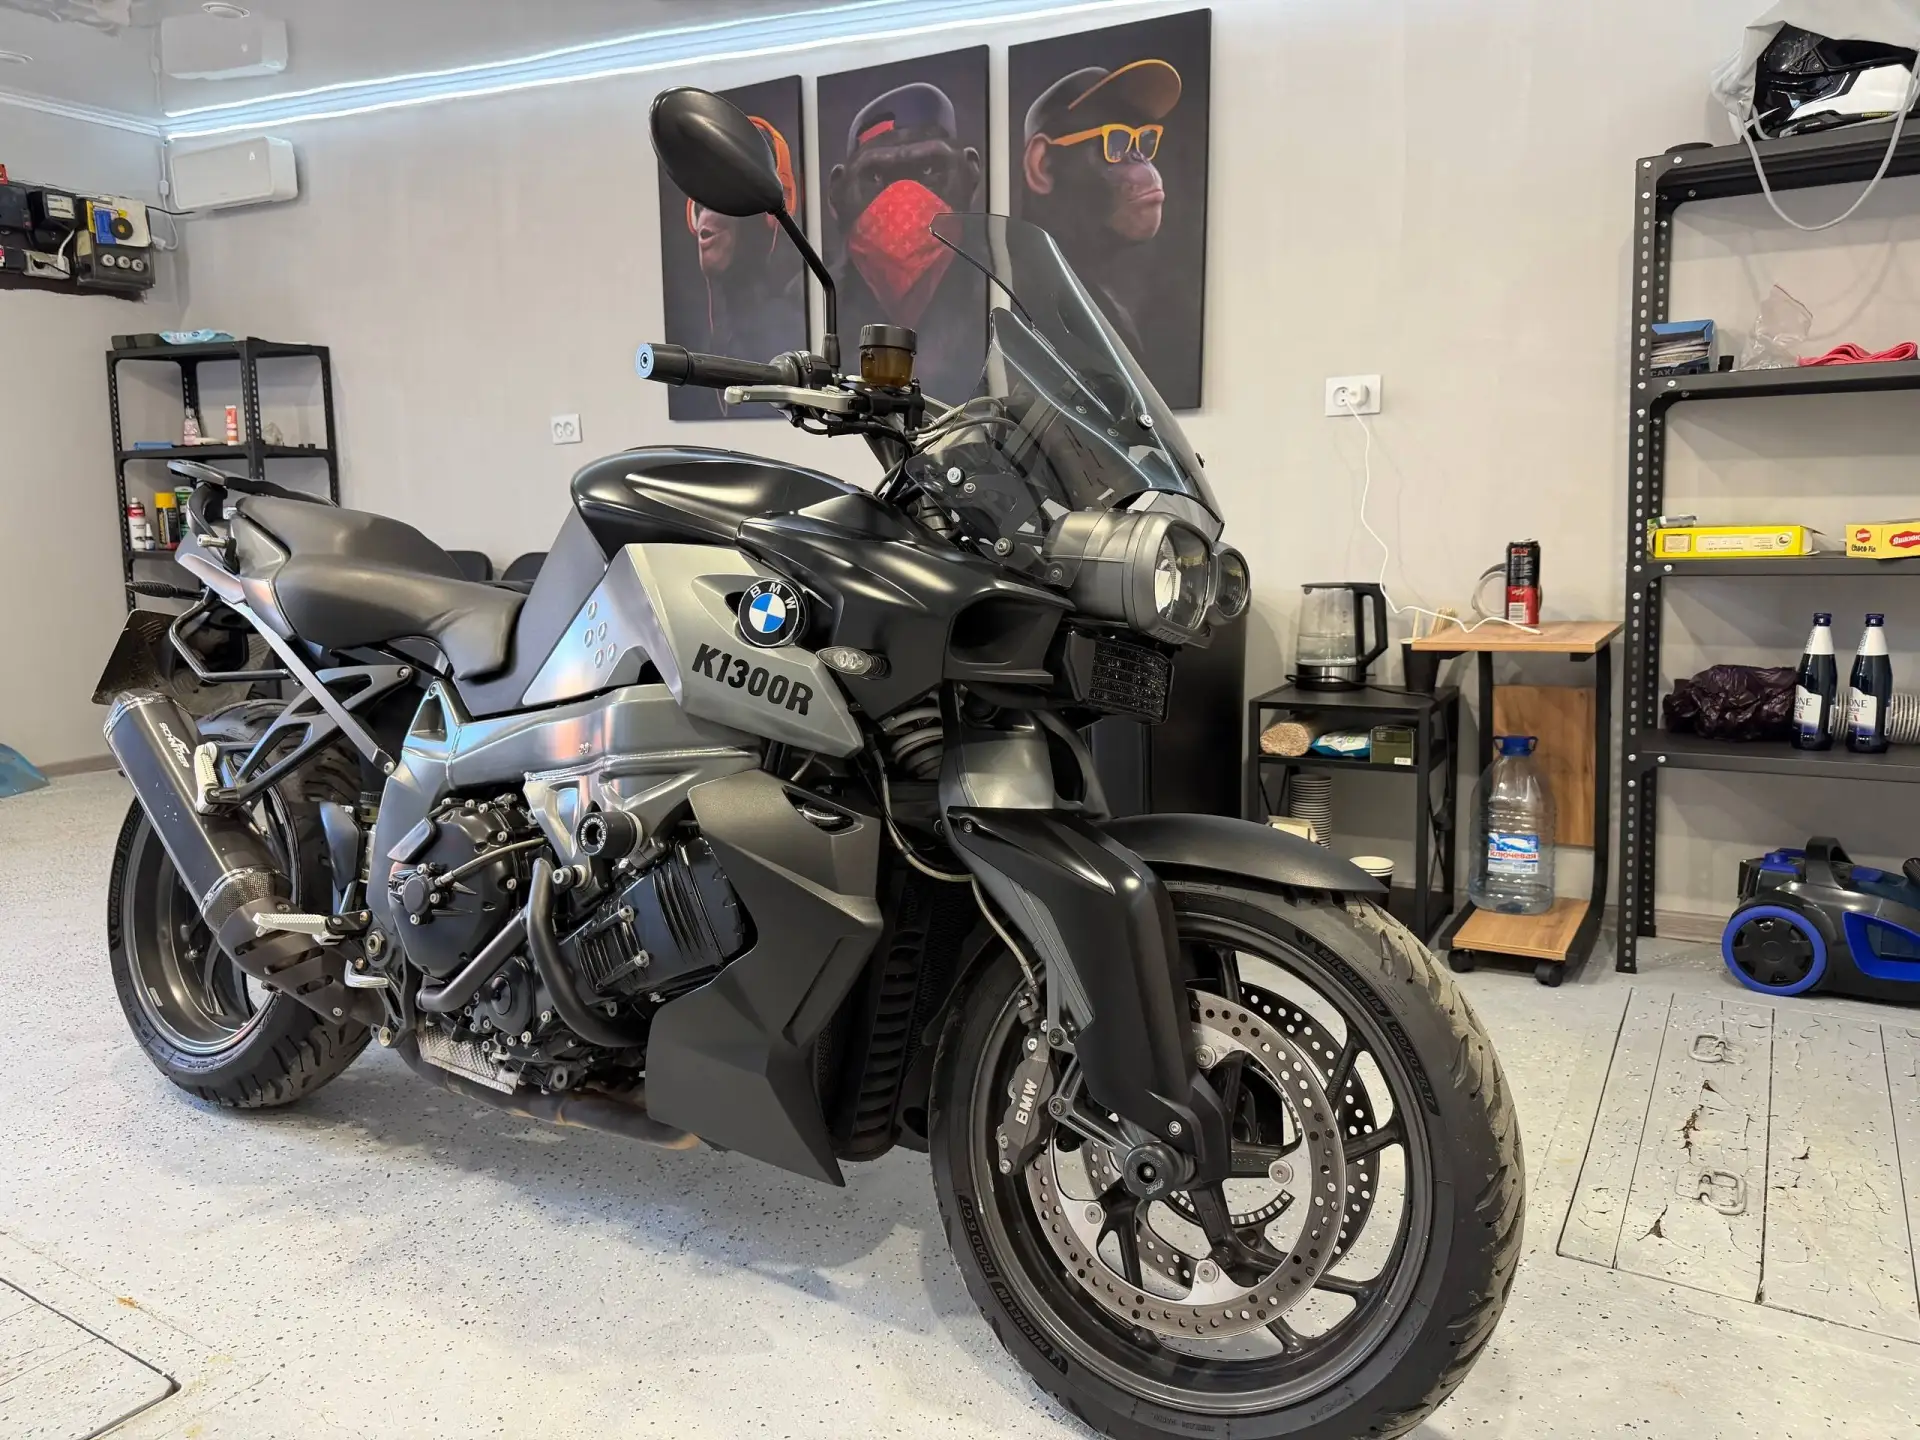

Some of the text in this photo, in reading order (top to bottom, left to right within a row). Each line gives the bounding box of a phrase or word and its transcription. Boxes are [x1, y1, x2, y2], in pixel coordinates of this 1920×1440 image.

[750, 583, 797, 610] BMW
[691, 643, 814, 716] K1300R
[1317, 948, 1386, 1015] MICHELIN
[1390, 1025, 1419, 1067] 120/70
[1015, 1078, 1038, 1125] BMW
[961, 1200, 973, 1219] GT
[972, 1236, 995, 1277] ROAD
[995, 1286, 1050, 1353] MICHELIN
